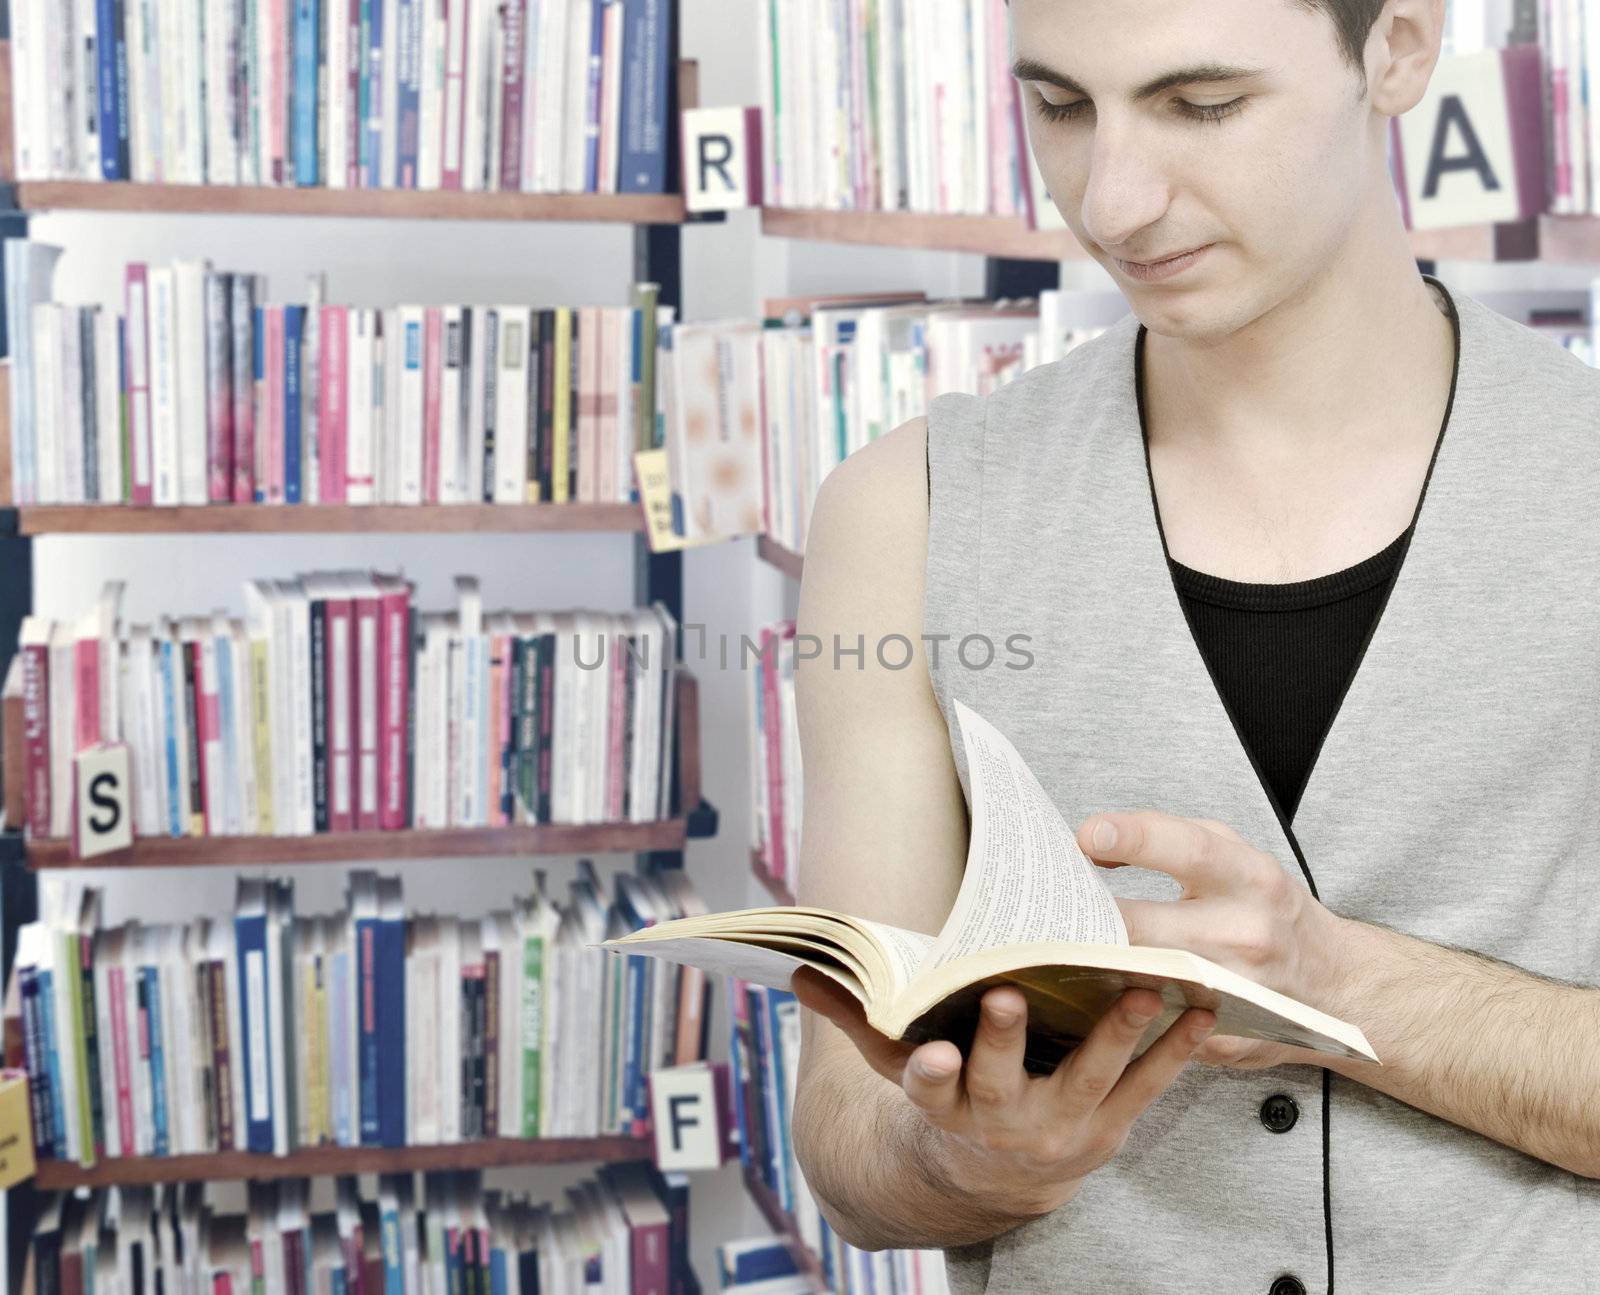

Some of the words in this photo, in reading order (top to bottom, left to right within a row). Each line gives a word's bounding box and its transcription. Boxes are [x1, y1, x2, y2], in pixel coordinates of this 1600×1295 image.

[698, 135, 736, 192] R
[1422, 95, 1500, 198] A
[88, 771, 122, 836] S
[668, 1094, 700, 1151] F
